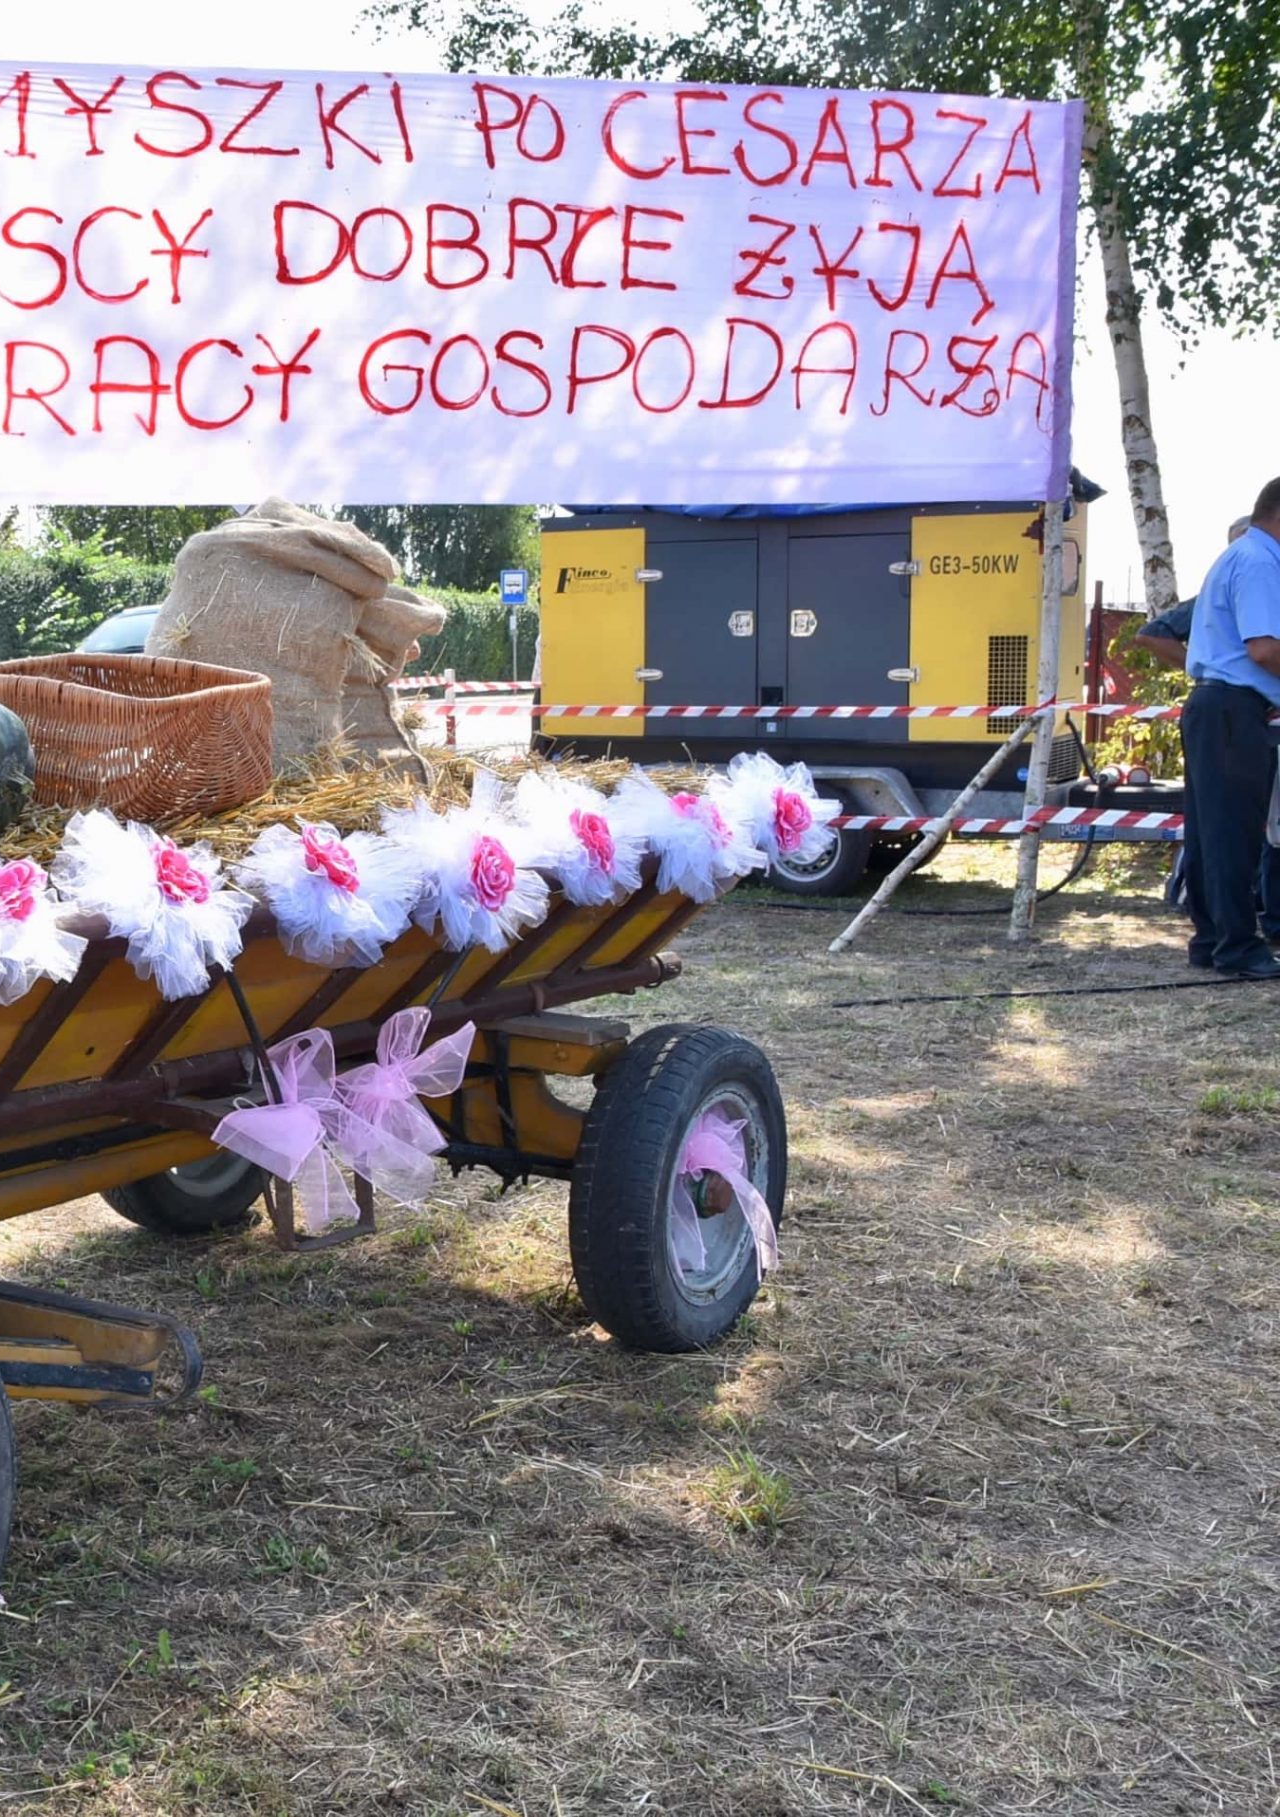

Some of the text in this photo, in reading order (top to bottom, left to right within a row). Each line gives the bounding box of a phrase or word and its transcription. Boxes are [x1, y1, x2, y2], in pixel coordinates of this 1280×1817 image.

[472, 82, 567, 169] PO
[602, 89, 1042, 200] CESARZA
[273, 197, 686, 295] DOBRZE
[554, 567, 612, 594] Finco
[929, 554, 1019, 575] GE3-50KW
